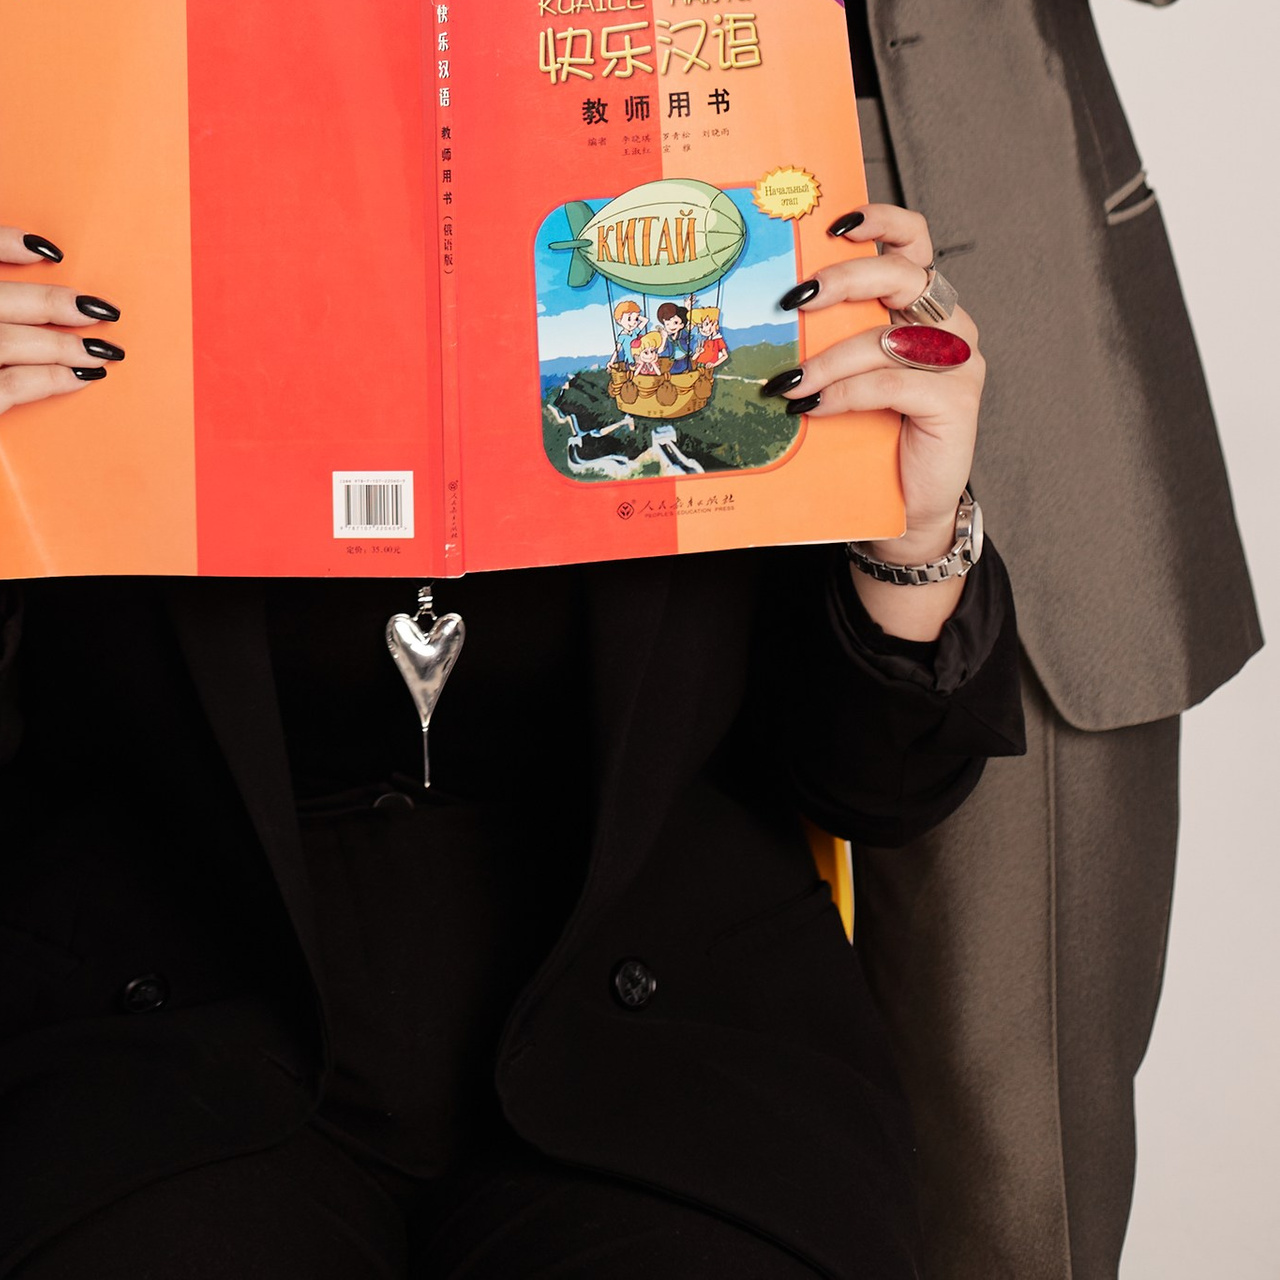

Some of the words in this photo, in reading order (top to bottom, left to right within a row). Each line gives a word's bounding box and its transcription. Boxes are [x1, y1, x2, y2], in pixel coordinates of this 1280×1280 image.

[436, 4, 451, 107] 快乐汉语
[538, 13, 762, 85] 快乐汉语
[581, 87, 731, 125] 教师用书
[441, 125, 452, 205] 教师用书
[764, 183, 810, 197] Начальный
[780, 196, 799, 207] этап
[596, 208, 697, 267] КИТАЙ
